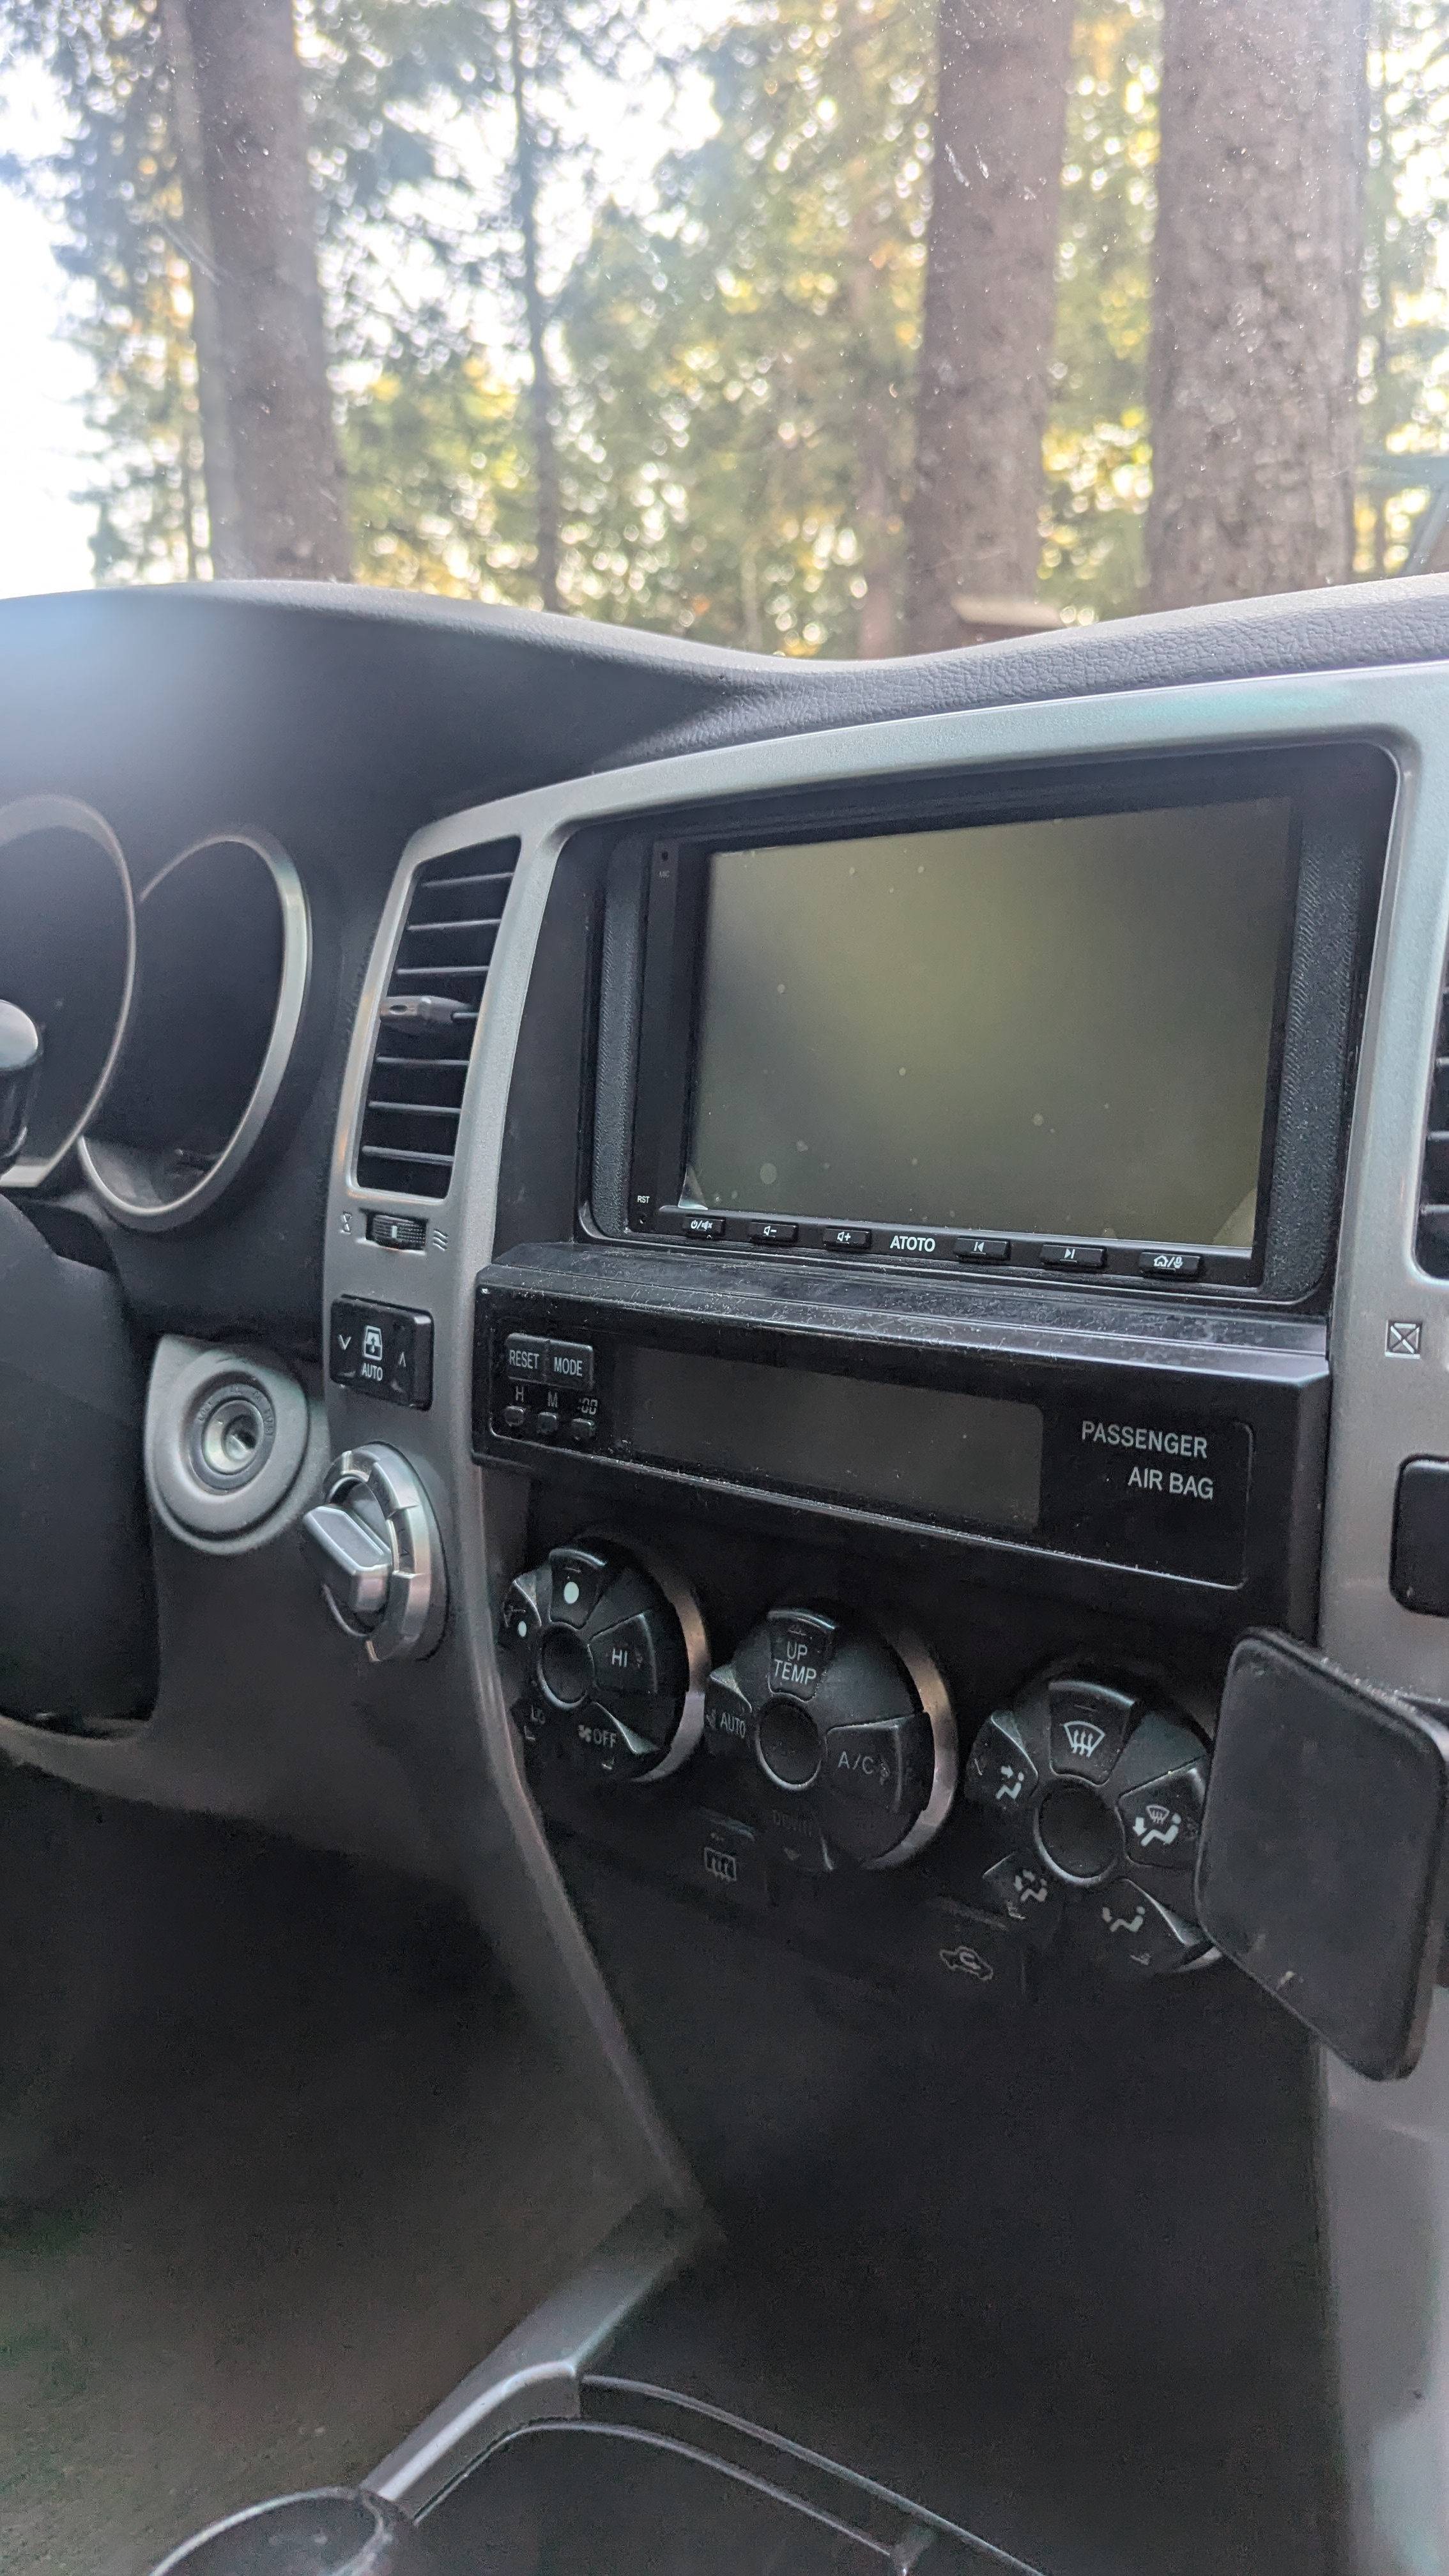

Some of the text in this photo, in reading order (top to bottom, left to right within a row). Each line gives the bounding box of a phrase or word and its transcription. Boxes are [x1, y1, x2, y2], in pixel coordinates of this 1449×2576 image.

[637, 1195, 650, 1204] RST
[889, 1235, 936, 1252] ATOTO
[509, 1349, 540, 1370] RESET
[553, 1356, 583, 1377] MODE
[362, 1362, 383, 1382] AUTO
[515, 1384, 525, 1402] H
[548, 1390, 558, 1408] M
[1082, 1420, 1208, 1459] PASSENGER
[1127, 1466, 1214, 1501] AIR BAG
[611, 1648, 628, 1667] HI
[786, 1641, 808, 1661] UP
[773, 1659, 817, 1685] TEMP
[719, 1712, 746, 1739] AUTO
[593, 1728, 617, 1749] OFF
[838, 1751, 874, 1775] A/C
